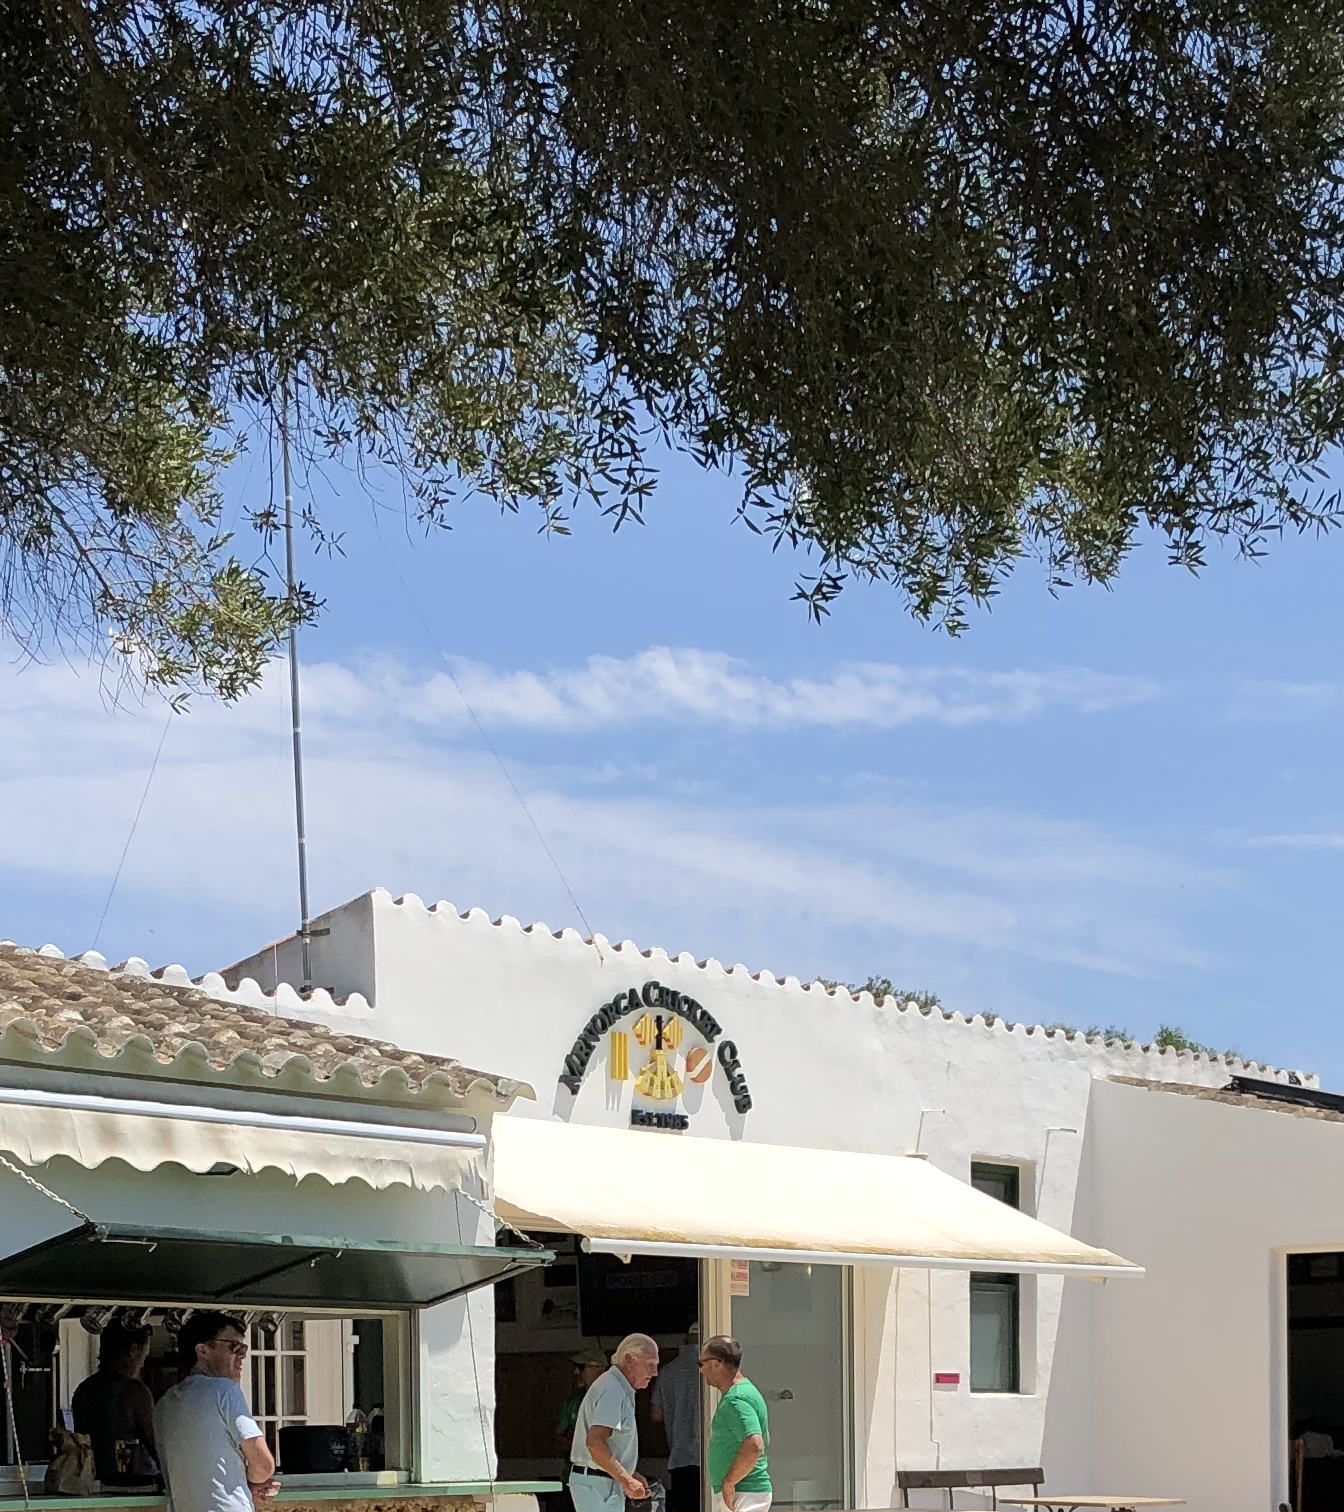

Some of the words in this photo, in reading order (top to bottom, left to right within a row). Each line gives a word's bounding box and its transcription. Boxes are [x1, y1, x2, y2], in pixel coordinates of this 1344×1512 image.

[558, 988, 645, 1096] MENORCA
[641, 980, 723, 1044] CRICKET
[716, 1040, 753, 1114] CLUB
